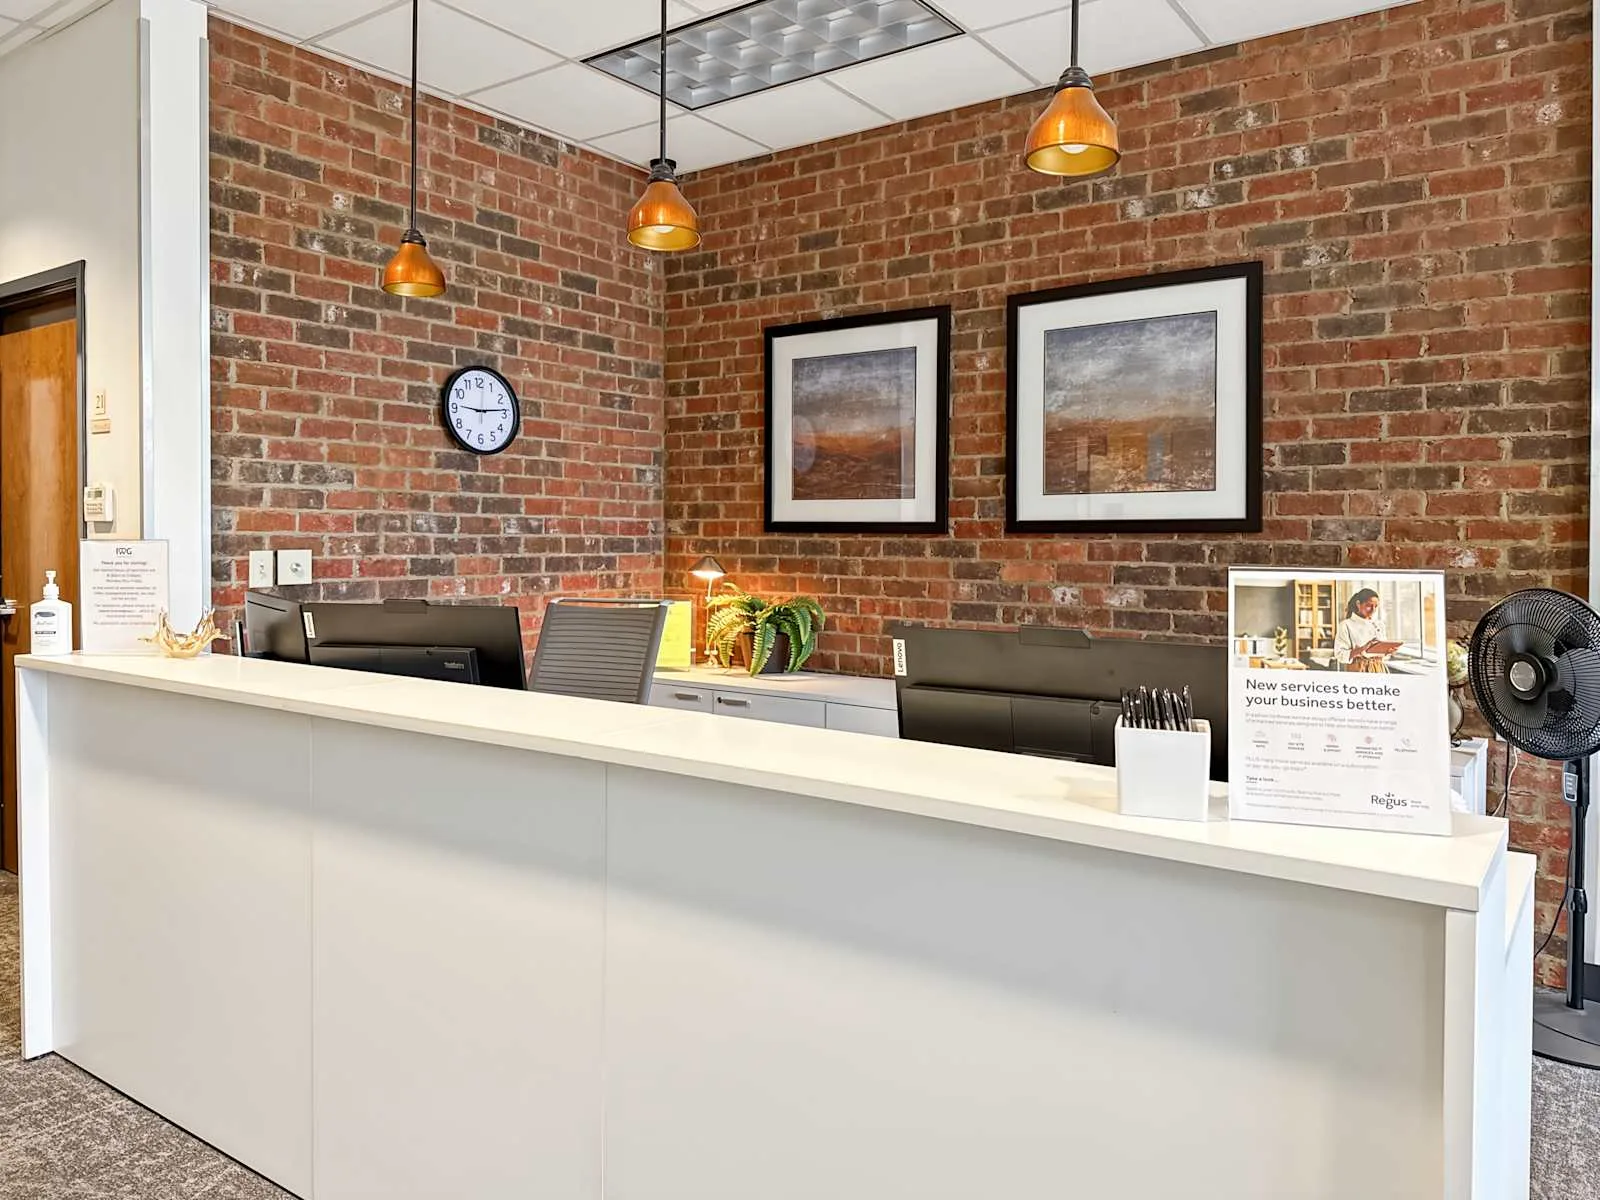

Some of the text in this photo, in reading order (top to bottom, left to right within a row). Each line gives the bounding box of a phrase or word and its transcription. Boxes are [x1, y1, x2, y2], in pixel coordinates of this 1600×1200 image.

[464, 379, 471, 390] 11
[475, 377, 484, 389] 12
[489, 382, 493, 393] 1
[455, 388, 465, 400] 10
[497, 393, 504, 405] 2
[451, 402, 458, 414] 9
[501, 408, 508, 420] 3
[456, 418, 463, 429] 8
[497, 423, 503, 433] 4
[466, 429, 472, 440] 7
[477, 433, 484, 445] 6
[490, 431, 496, 442] 5
[1246, 679, 1400, 697] New services to make
[1246, 695, 1396, 712] your business better.
[1371, 793, 1407, 810] Regus
